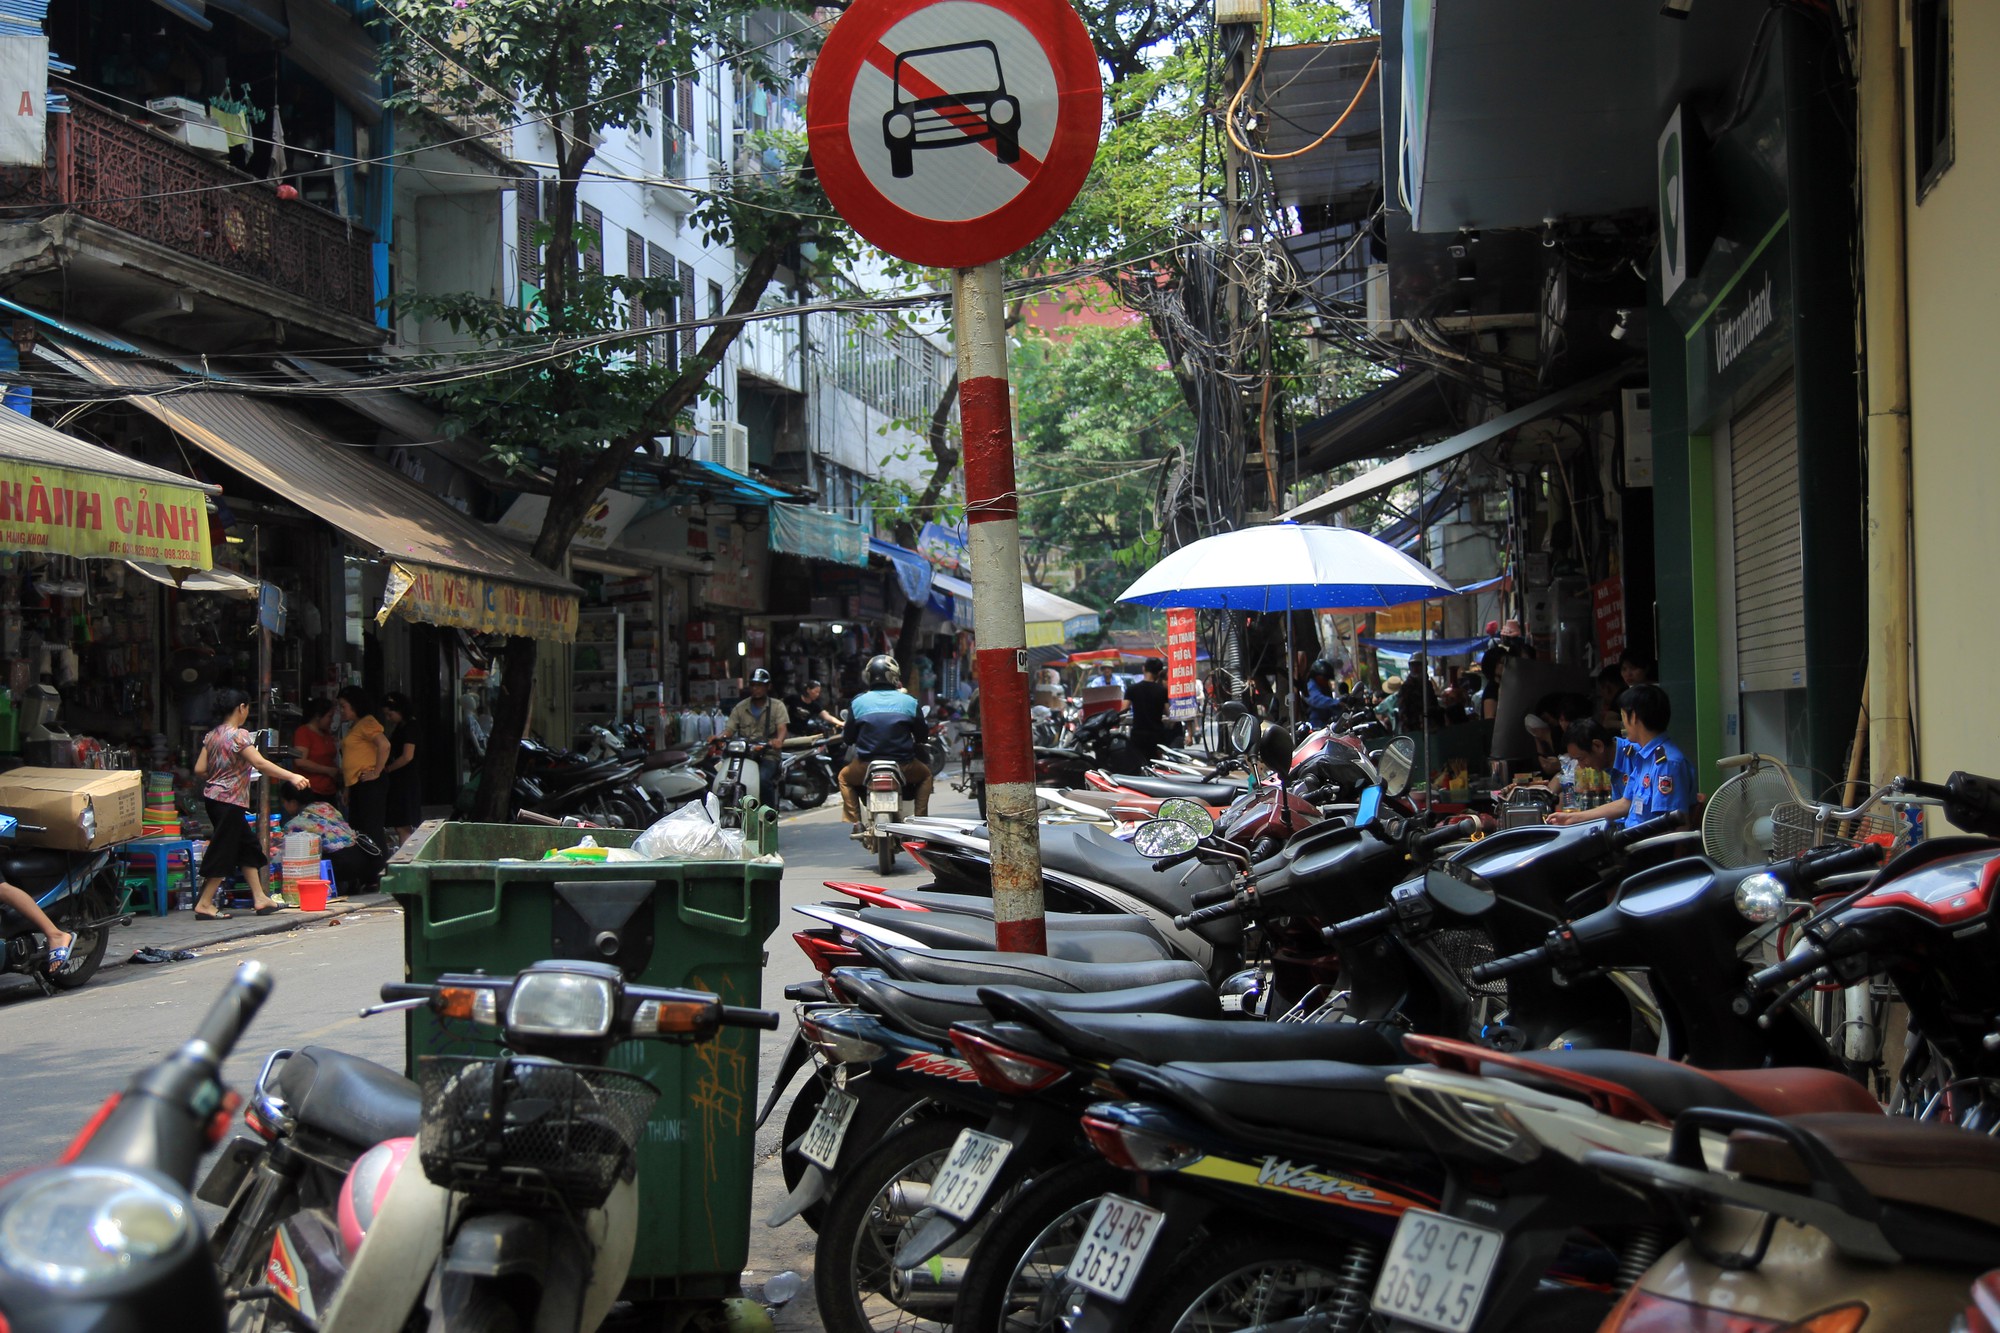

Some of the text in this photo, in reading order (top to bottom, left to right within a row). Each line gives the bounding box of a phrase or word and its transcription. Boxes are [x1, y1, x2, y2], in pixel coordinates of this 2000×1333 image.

[18, 91, 33, 117] A
[1715, 269, 1773, 374] Vietcombank
[27, 533, 49, 546] KHOAI
[114, 487, 200, 543] CẢNH
[804, 1122, 836, 1162] 5200
[951, 1136, 1000, 1176] 30-H6
[933, 1170, 979, 1211] 2913
[1257, 1155, 1393, 1206] Wave
[1093, 1202, 1153, 1251] 29-R5
[1402, 1220, 1484, 1277] 29-C1
[1076, 1242, 1131, 1292] 3633
[1379, 1264, 1476, 1326] 369.45
